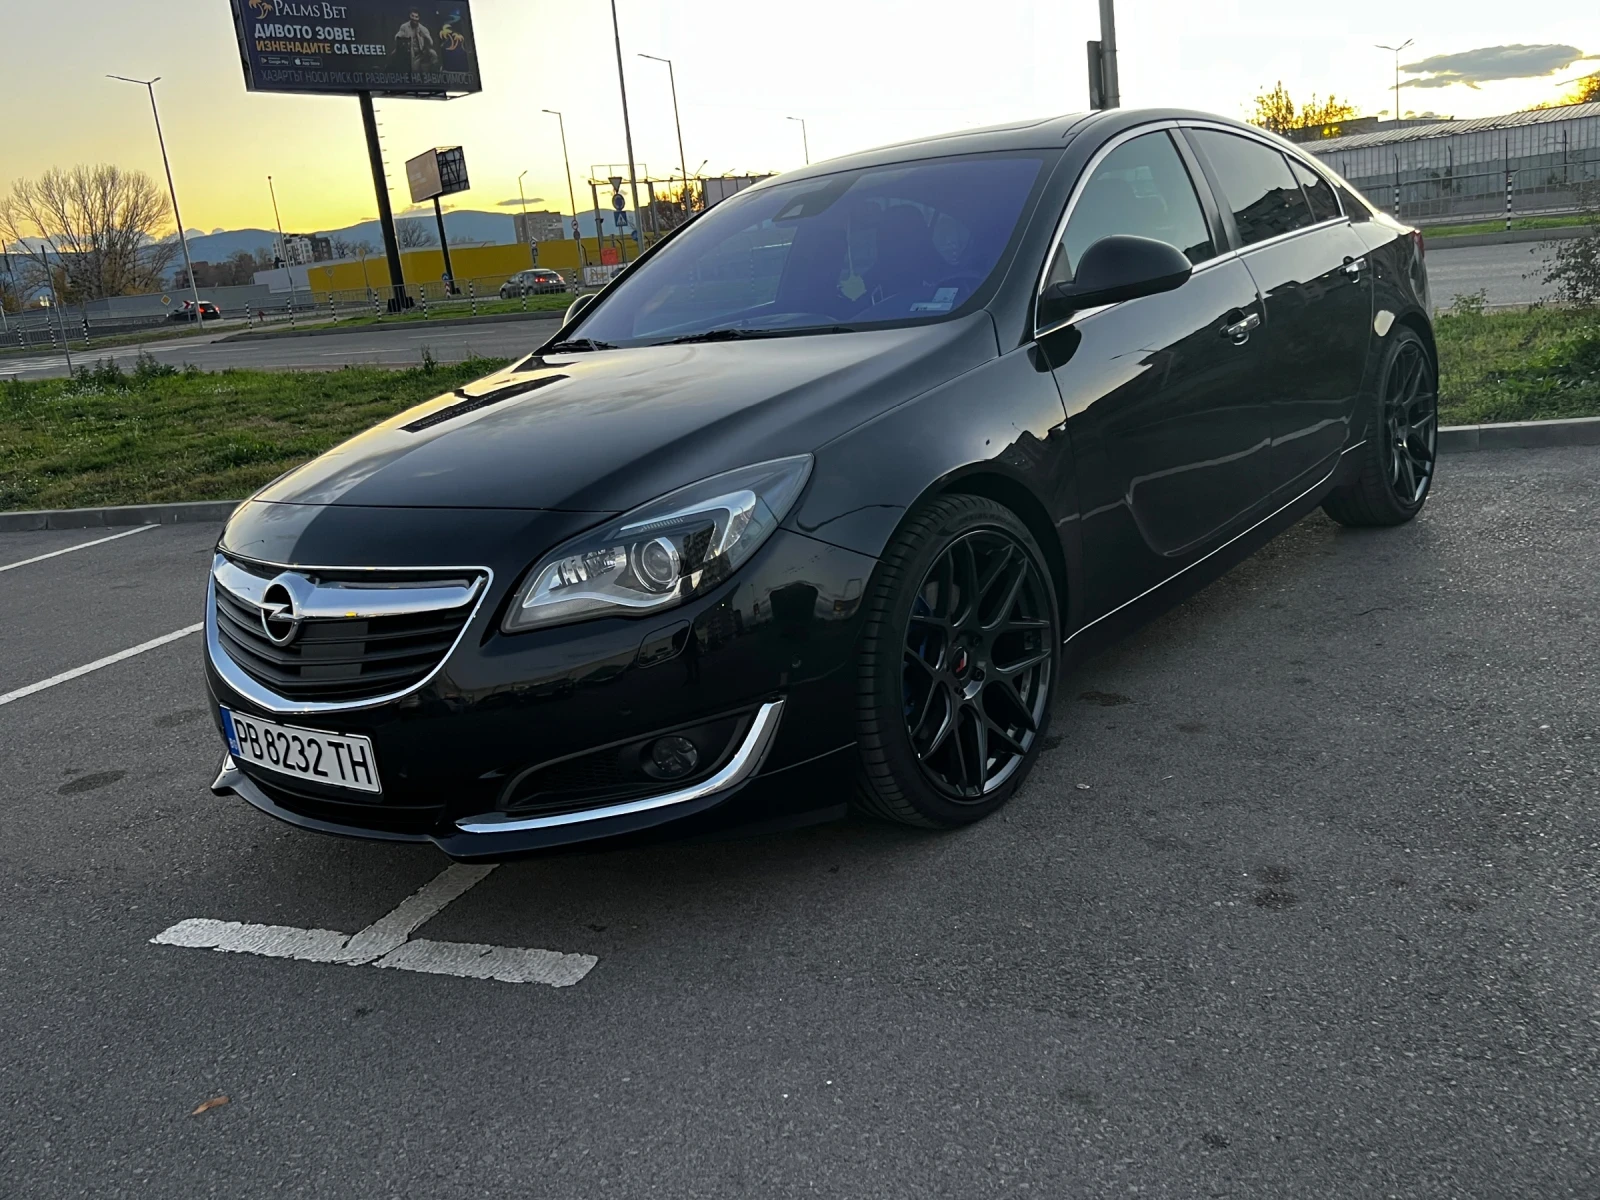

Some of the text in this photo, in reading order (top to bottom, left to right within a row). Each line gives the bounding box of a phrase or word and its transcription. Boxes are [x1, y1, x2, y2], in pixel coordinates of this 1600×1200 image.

[254, 23, 355, 41] ДИВОТО ЗОВЕ!
[255, 40, 386, 55] ИЗНЕНАДИТЕ СА ЕХЕЕЕ!
[260, 69, 303, 82] ХАЗАРТЪТ
[305, 71, 329, 83] НОСИ
[330, 71, 352, 83] РИСК
[353, 72, 364, 83] ОТ
[365, 72, 410, 84] РАЗВИВАНЕ
[411, 72, 422, 83] НА
